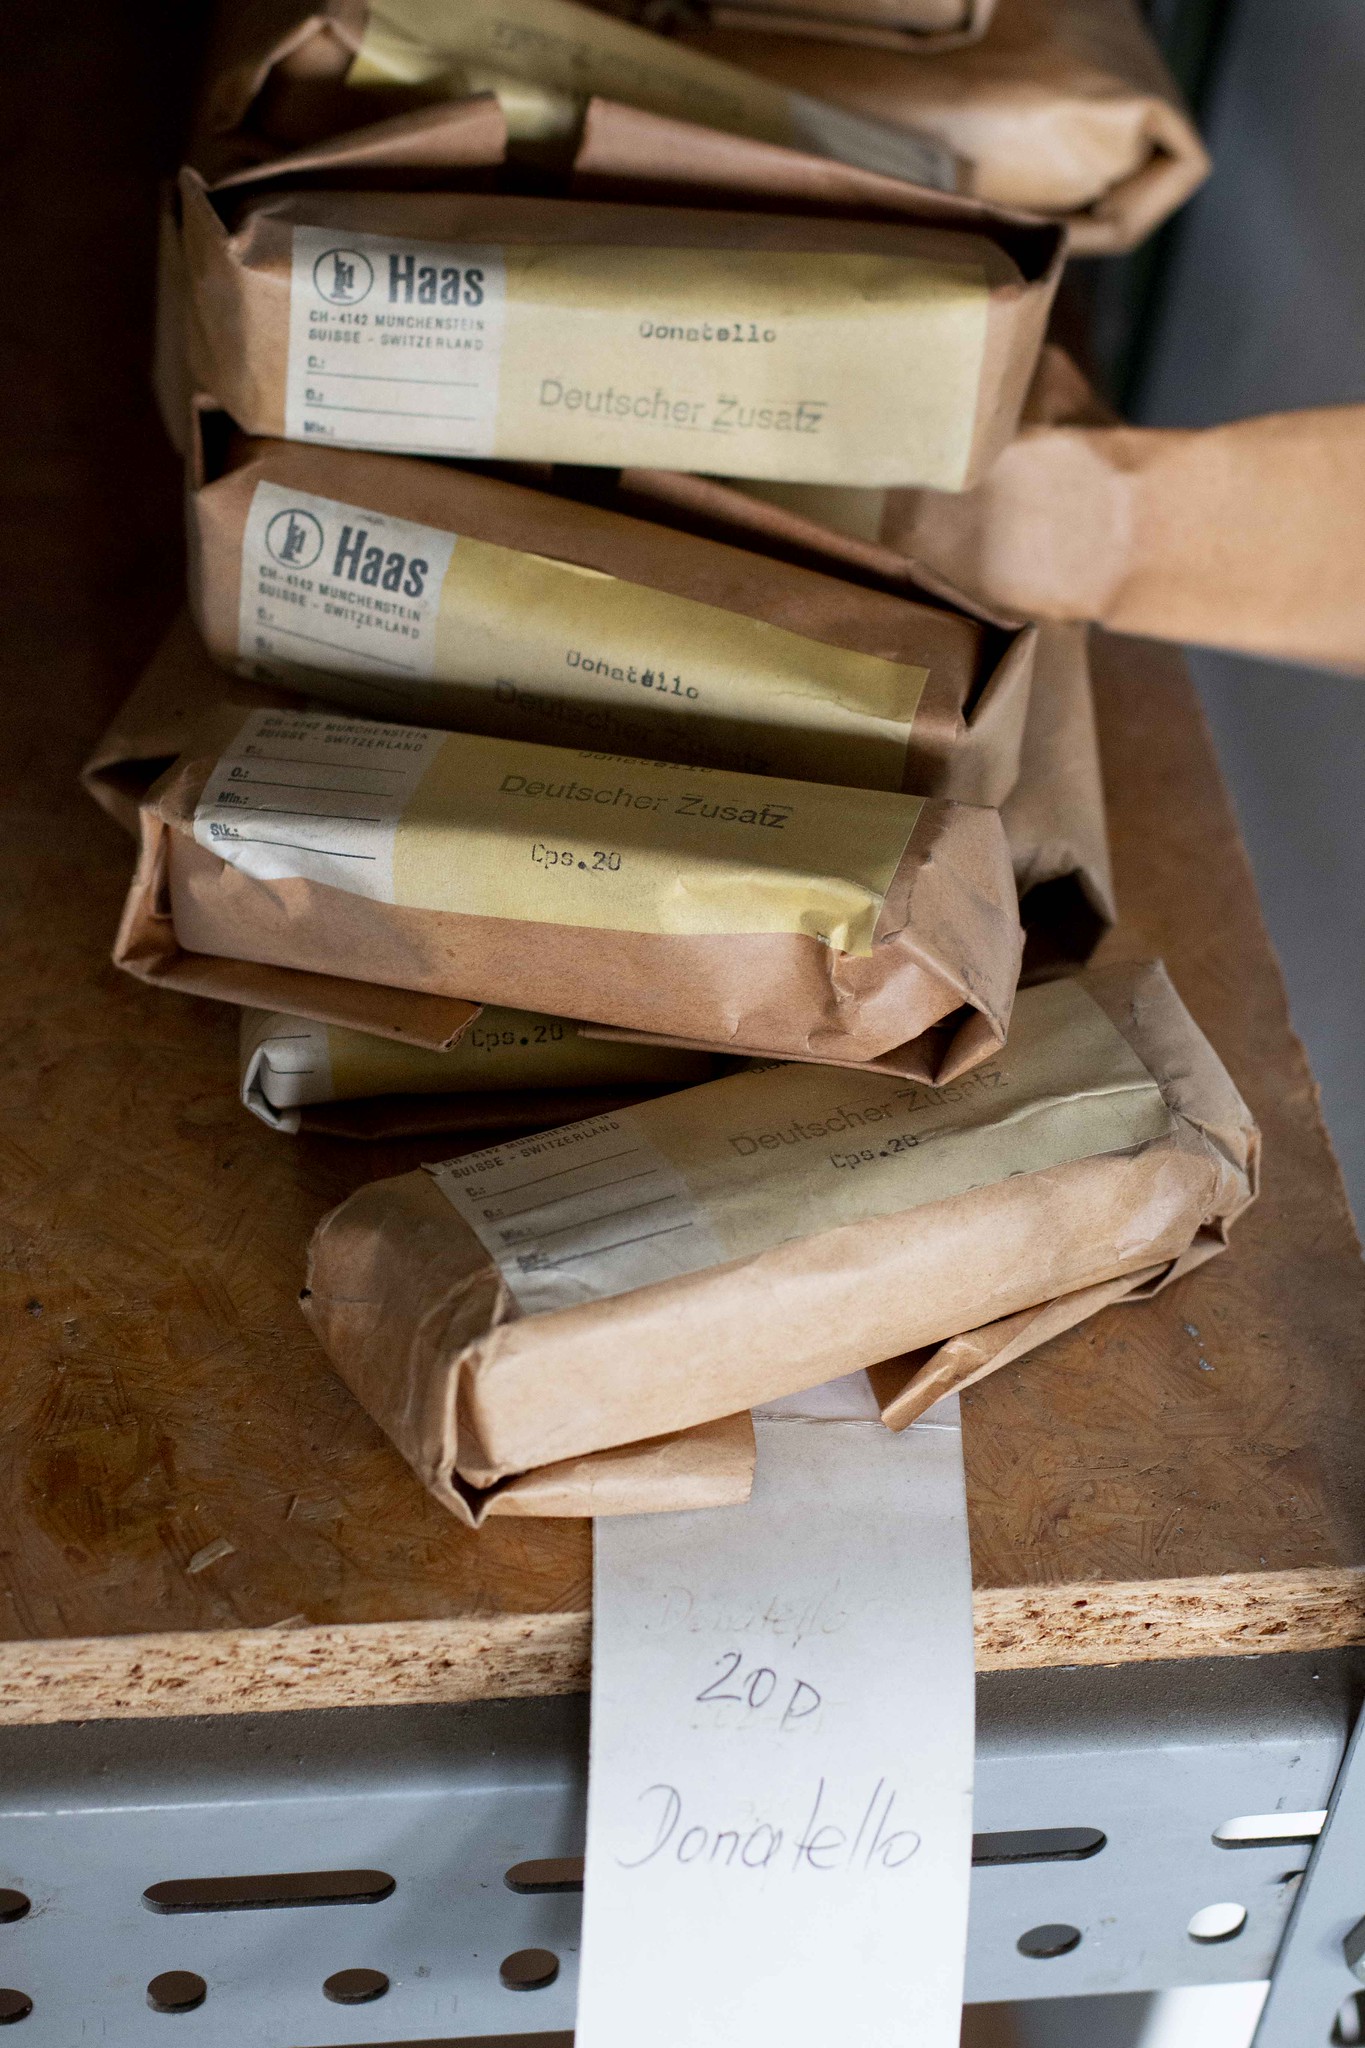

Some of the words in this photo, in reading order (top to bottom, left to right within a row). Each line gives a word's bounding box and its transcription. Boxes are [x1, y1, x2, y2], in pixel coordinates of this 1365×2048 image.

[387, 253, 485, 307] Haas
[308, 328, 361, 345] SUISSE
[380, 333, 484, 351] SWITZERLAND
[639, 319, 777, 343] Donatello
[539, 378, 706, 425] Deutscher
[711, 396, 826, 434] Zusatz
[332, 525, 429, 598] Haas
[258, 581, 307, 608] SUISSE
[324, 602, 420, 640] SWITZERLAND
[256, 728, 307, 740] SUISSE
[323, 733, 423, 752] SWITZERLAND
[499, 773, 668, 812] Deutscher
[674, 794, 793, 830] Zusatz
[451, 1156, 505, 1179] SUISSE
[520, 1121, 621, 1158] SWITZERLAND
[727, 1103, 894, 1157] Deutscher
[616, 1776, 922, 1873] Donatello
